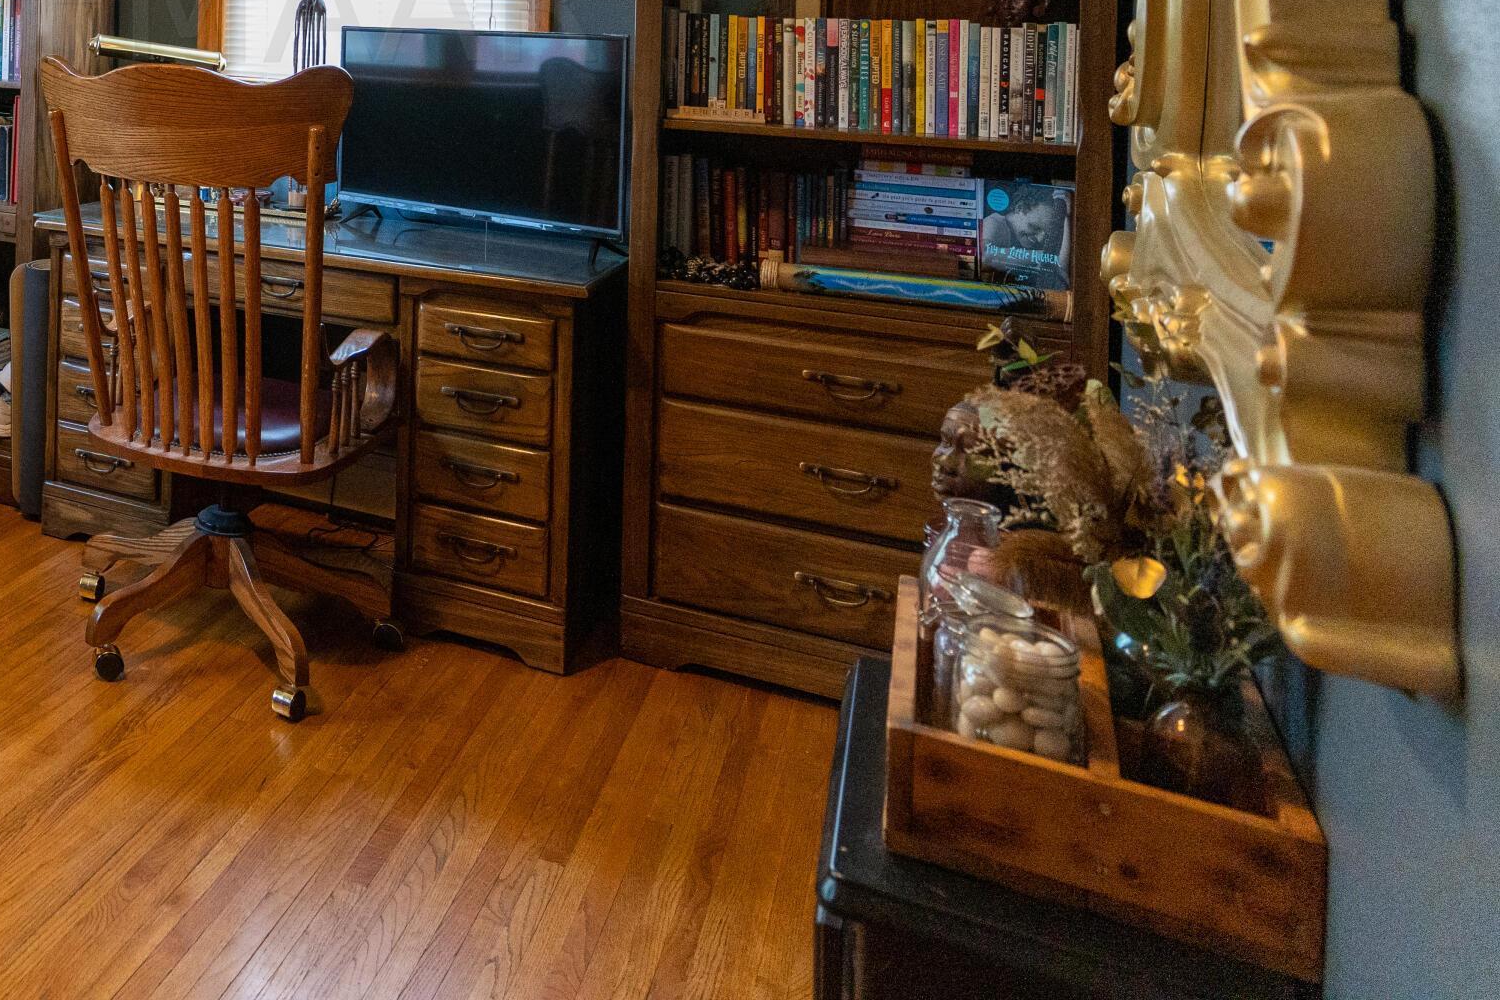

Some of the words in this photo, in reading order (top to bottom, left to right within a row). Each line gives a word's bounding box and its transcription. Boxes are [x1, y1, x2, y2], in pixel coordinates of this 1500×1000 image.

[860, 38, 869, 57] LOVE
[1026, 29, 1034, 53] HOPE
[738, 33, 746, 79] INTERRUPTED
[840, 61, 848, 88] ALWAYS
[860, 60, 869, 81] DOES
[985, 242, 998, 257] Fly
[1007, 246, 1030, 260] Little
